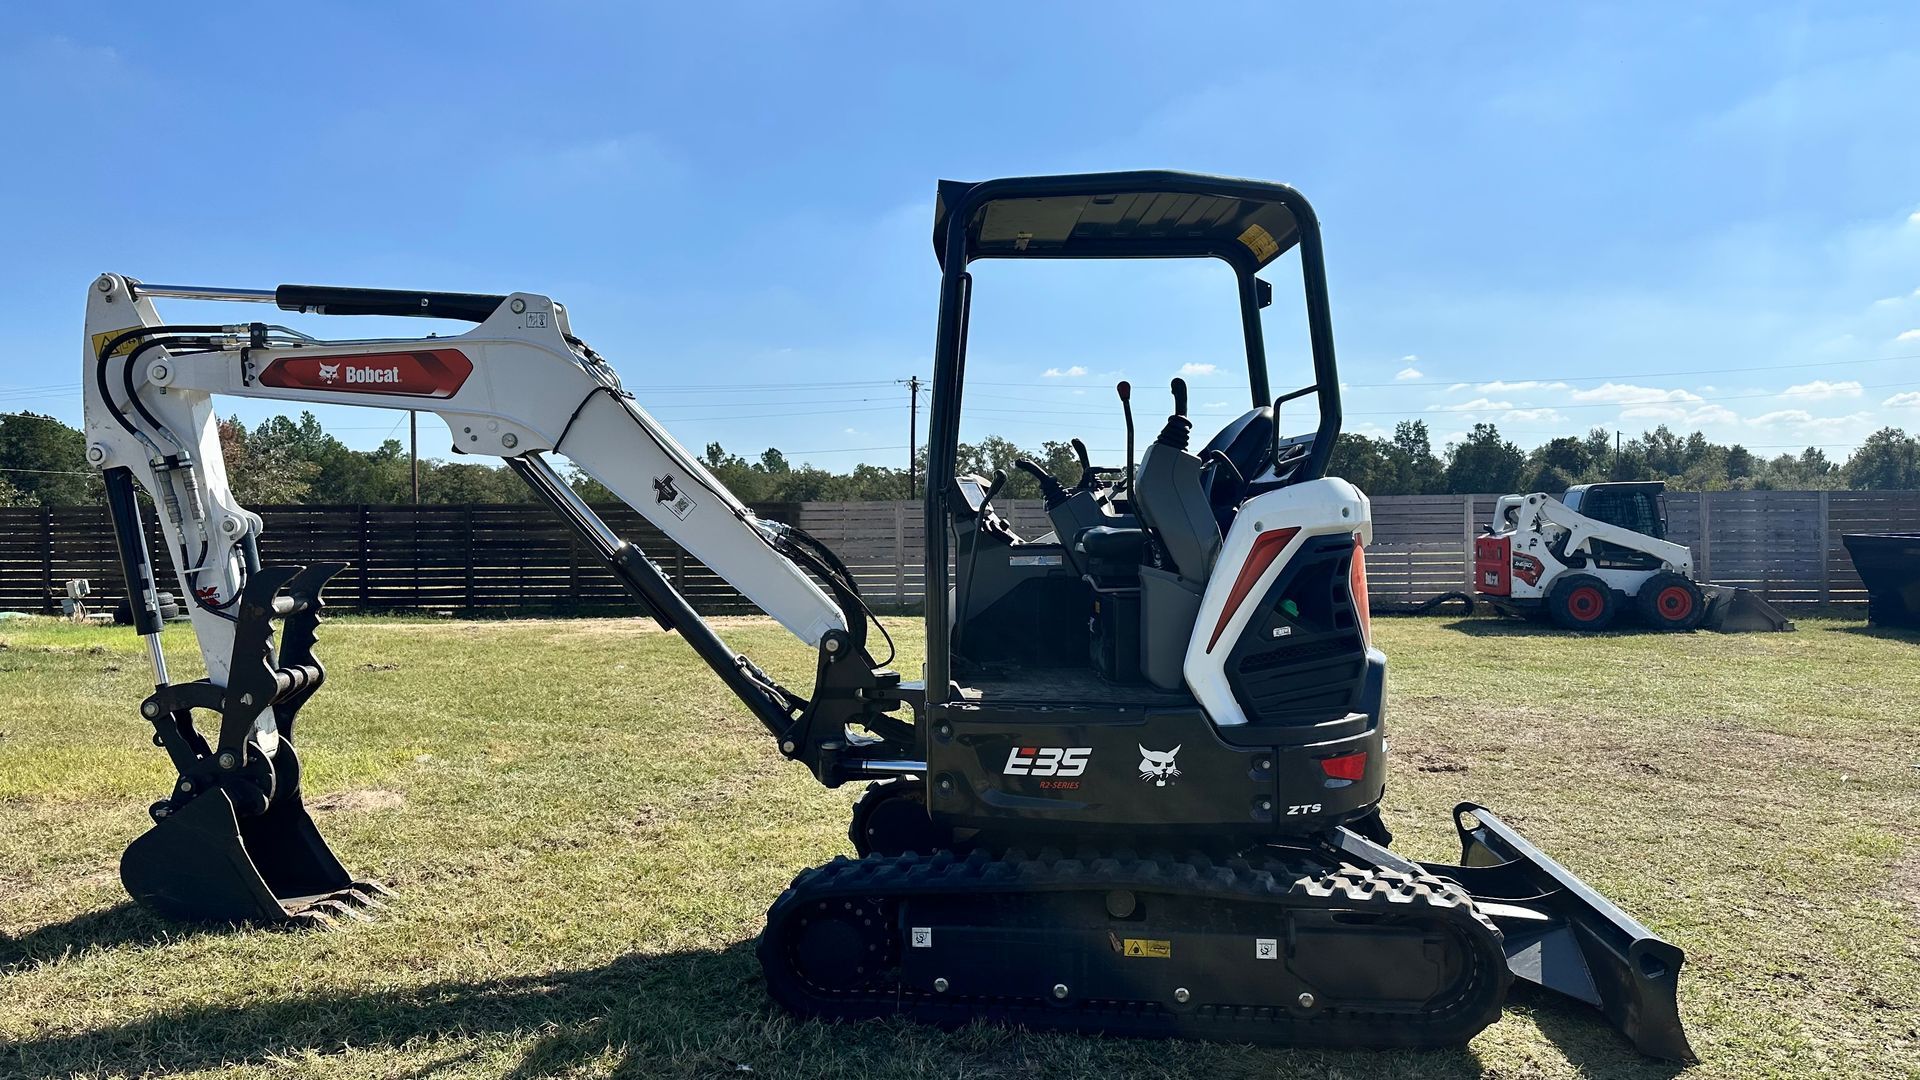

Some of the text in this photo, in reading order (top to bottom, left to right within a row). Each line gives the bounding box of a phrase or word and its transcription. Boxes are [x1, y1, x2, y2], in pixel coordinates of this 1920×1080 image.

[345, 366, 399, 383] Bobcat
[1003, 747, 1093, 777] E35
[1040, 781, 1080, 790] R2-SERIES
[1286, 803, 1322, 816] ZTS
